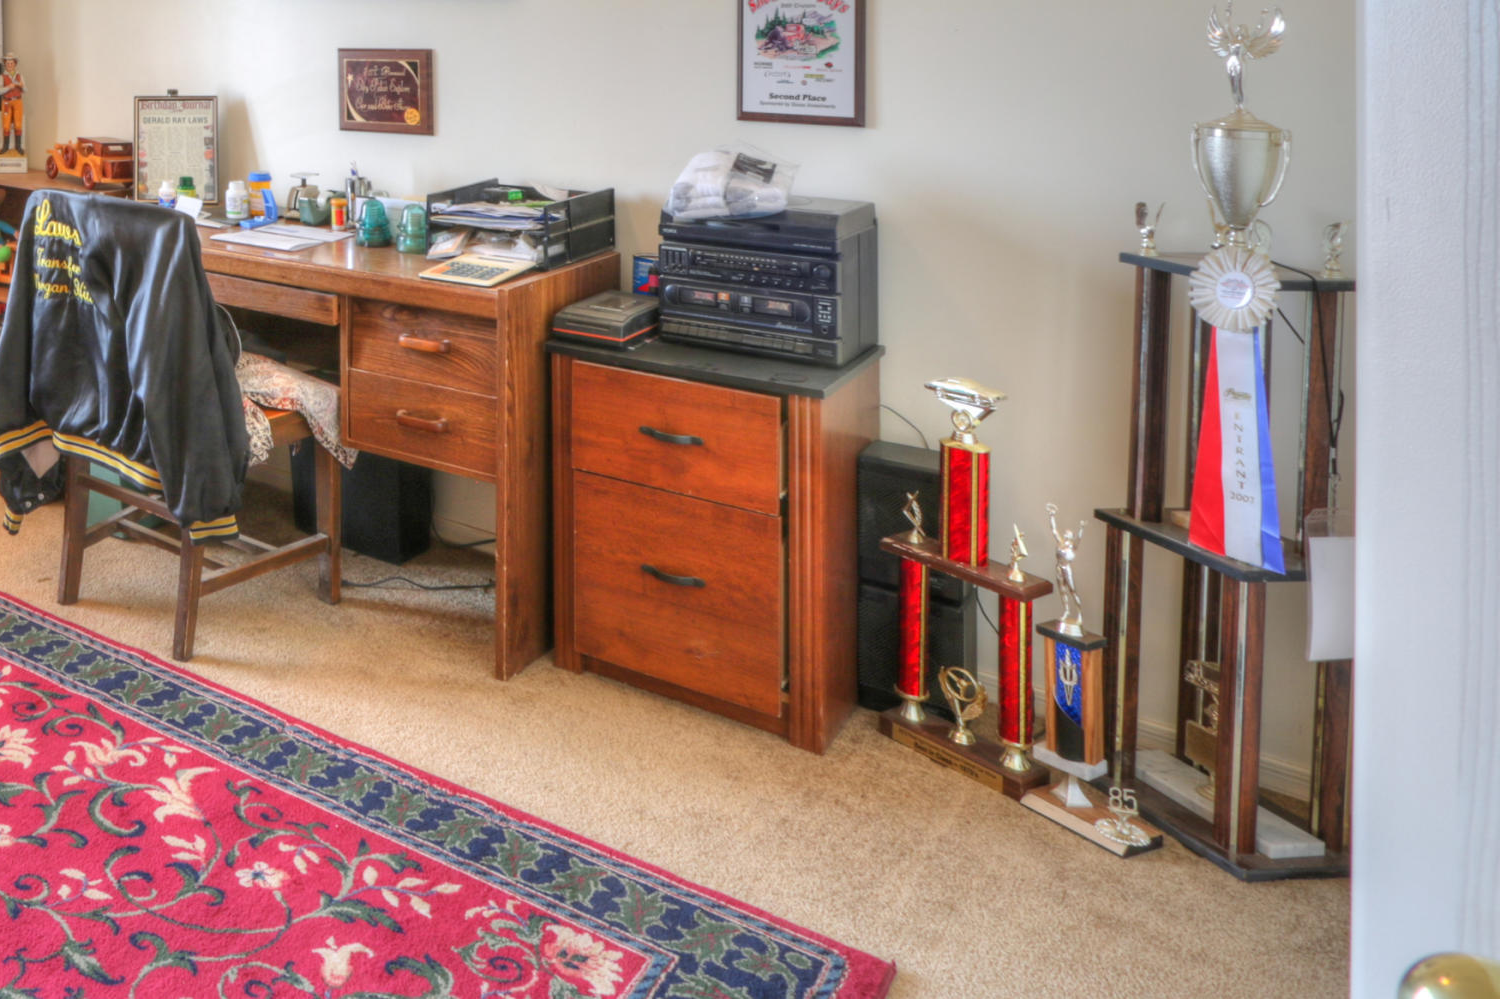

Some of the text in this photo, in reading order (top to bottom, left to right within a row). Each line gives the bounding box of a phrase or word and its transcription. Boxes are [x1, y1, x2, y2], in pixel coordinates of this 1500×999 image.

[769, 92, 827, 103] Second Place
[188, 116, 209, 124] LAWS
[1108, 786, 1139, 813] 85
